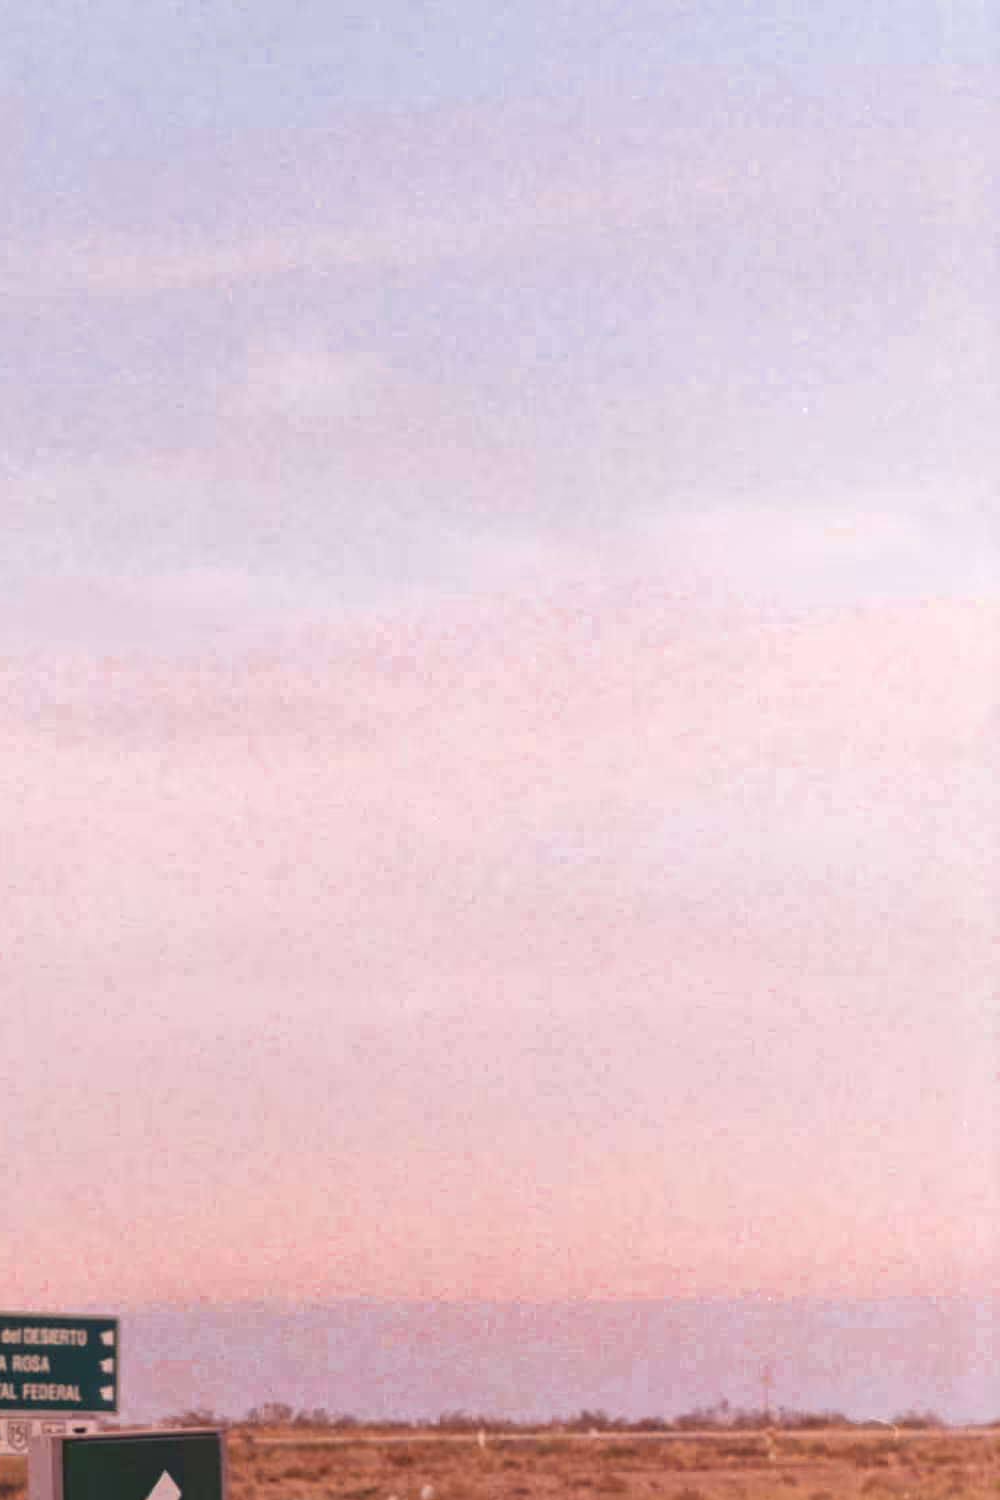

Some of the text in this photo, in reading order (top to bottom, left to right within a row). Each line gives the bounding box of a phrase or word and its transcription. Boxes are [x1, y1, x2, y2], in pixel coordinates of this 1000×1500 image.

[1, 1327, 21, 1344] del
[23, 1327, 88, 1346] DESIERTO
[12, 1354, 51, 1373] ROSA
[22, 1383, 82, 1402] FEDERAL
